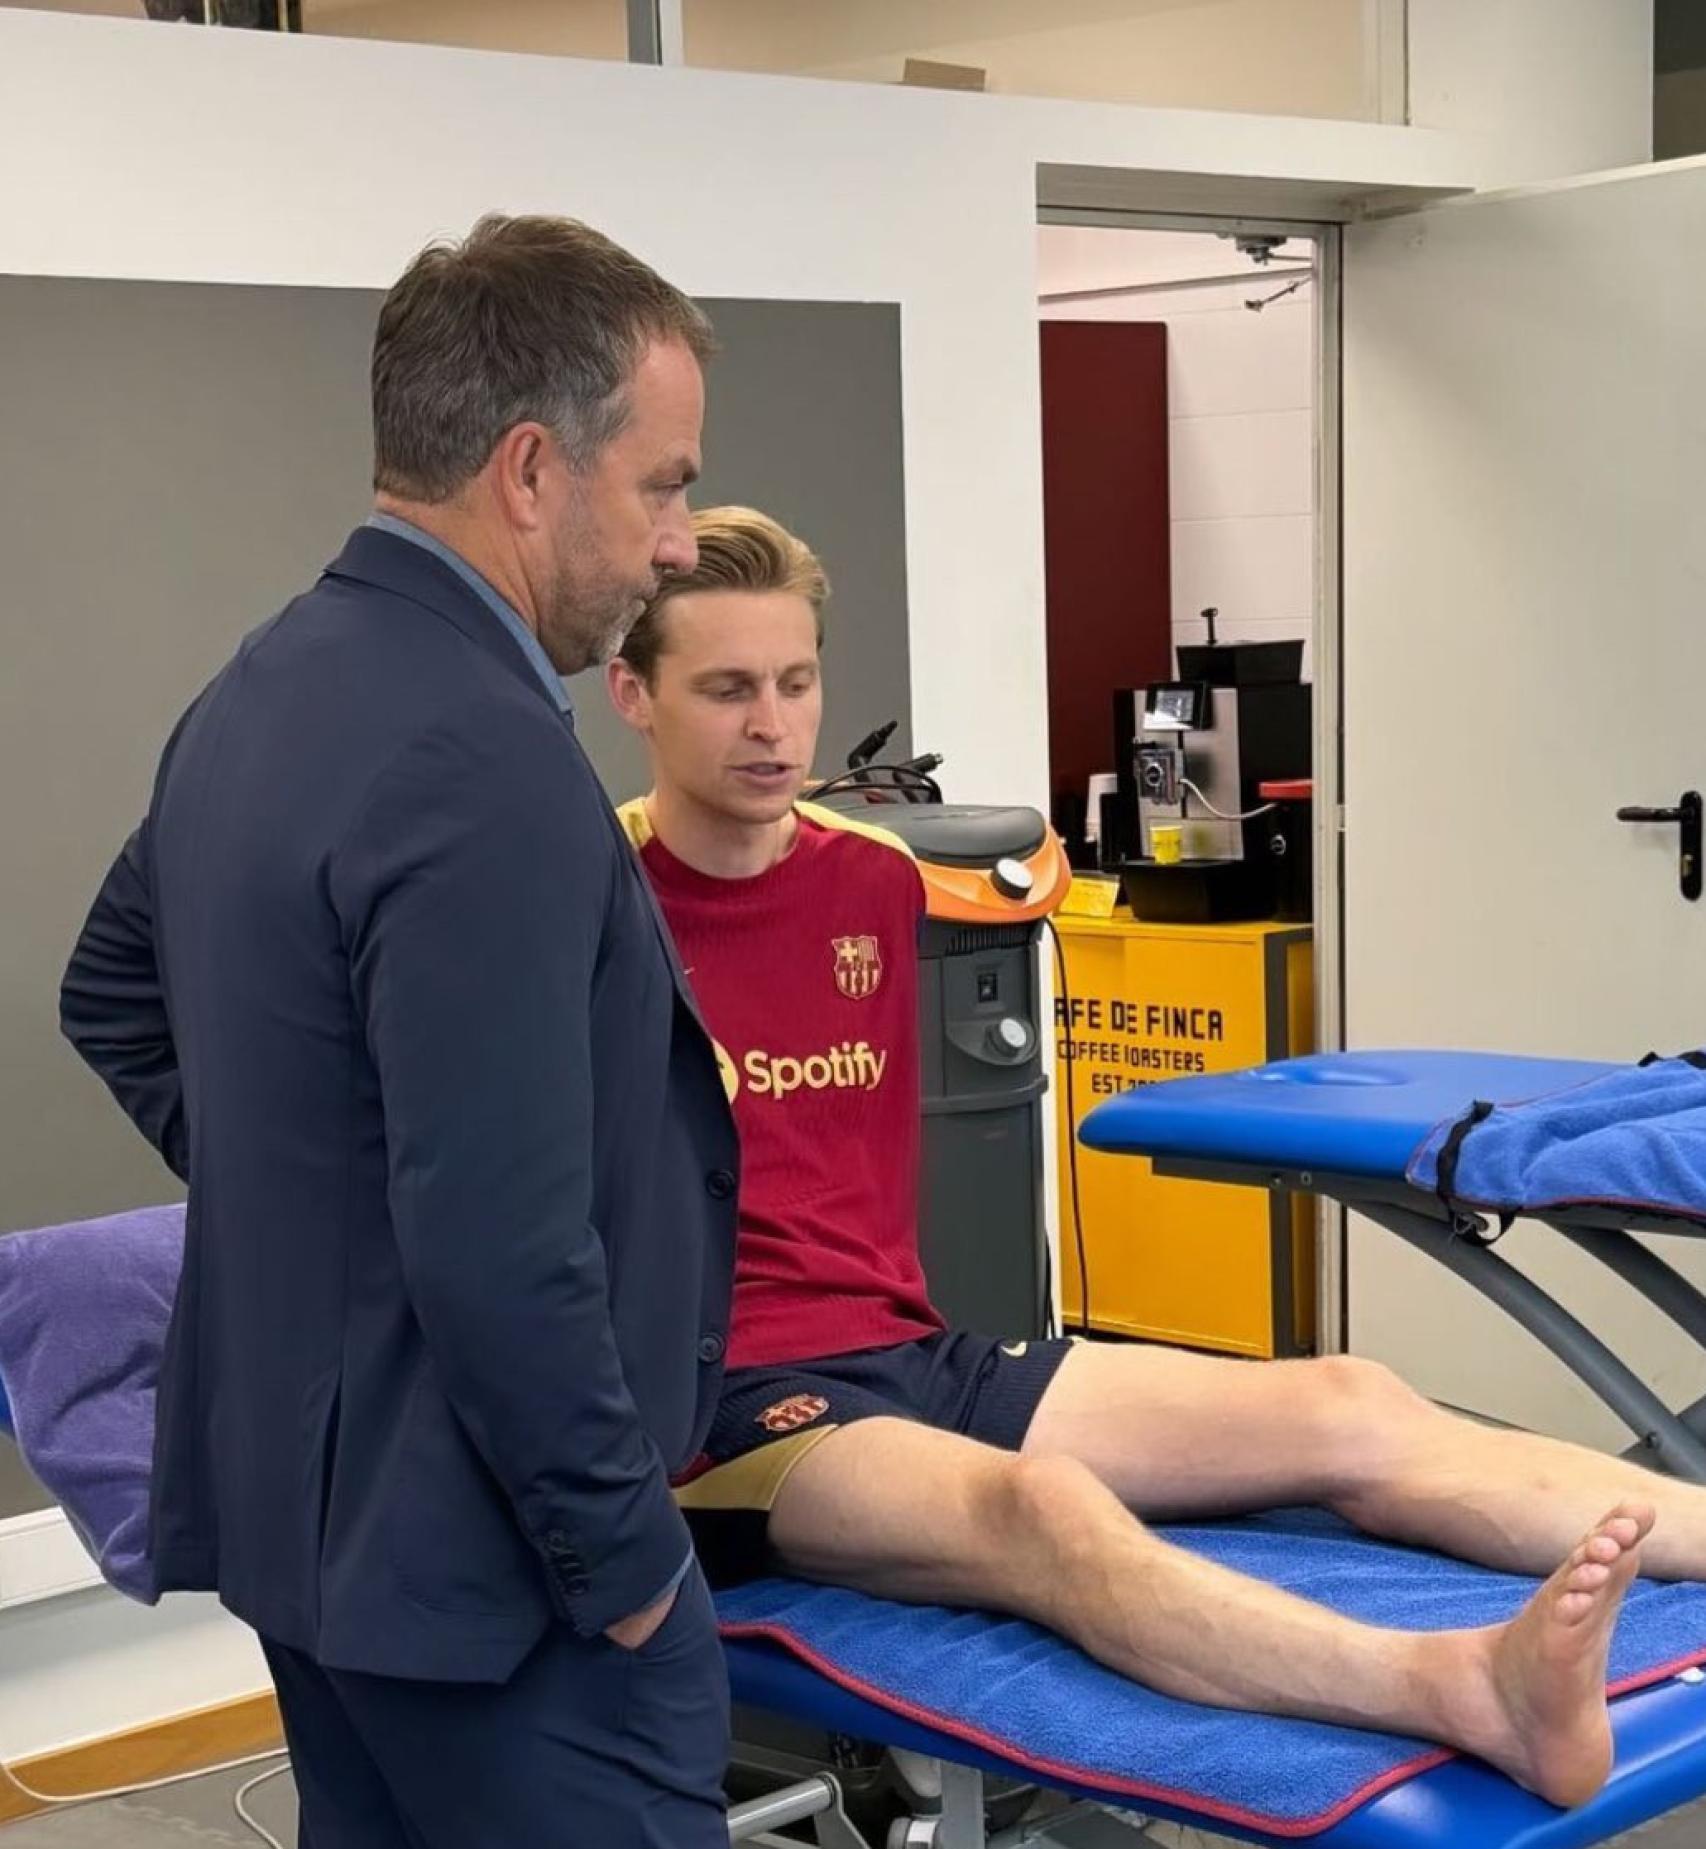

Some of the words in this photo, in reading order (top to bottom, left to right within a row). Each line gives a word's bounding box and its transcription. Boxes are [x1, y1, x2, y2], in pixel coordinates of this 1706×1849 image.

[1054, 998, 1101, 1029] AFE
[1111, 1000, 1137, 1034] DE
[1147, 1005, 1223, 1041] FINCA
[744, 1041, 887, 1099] Spotify
[1057, 1040, 1120, 1063] COFFEE
